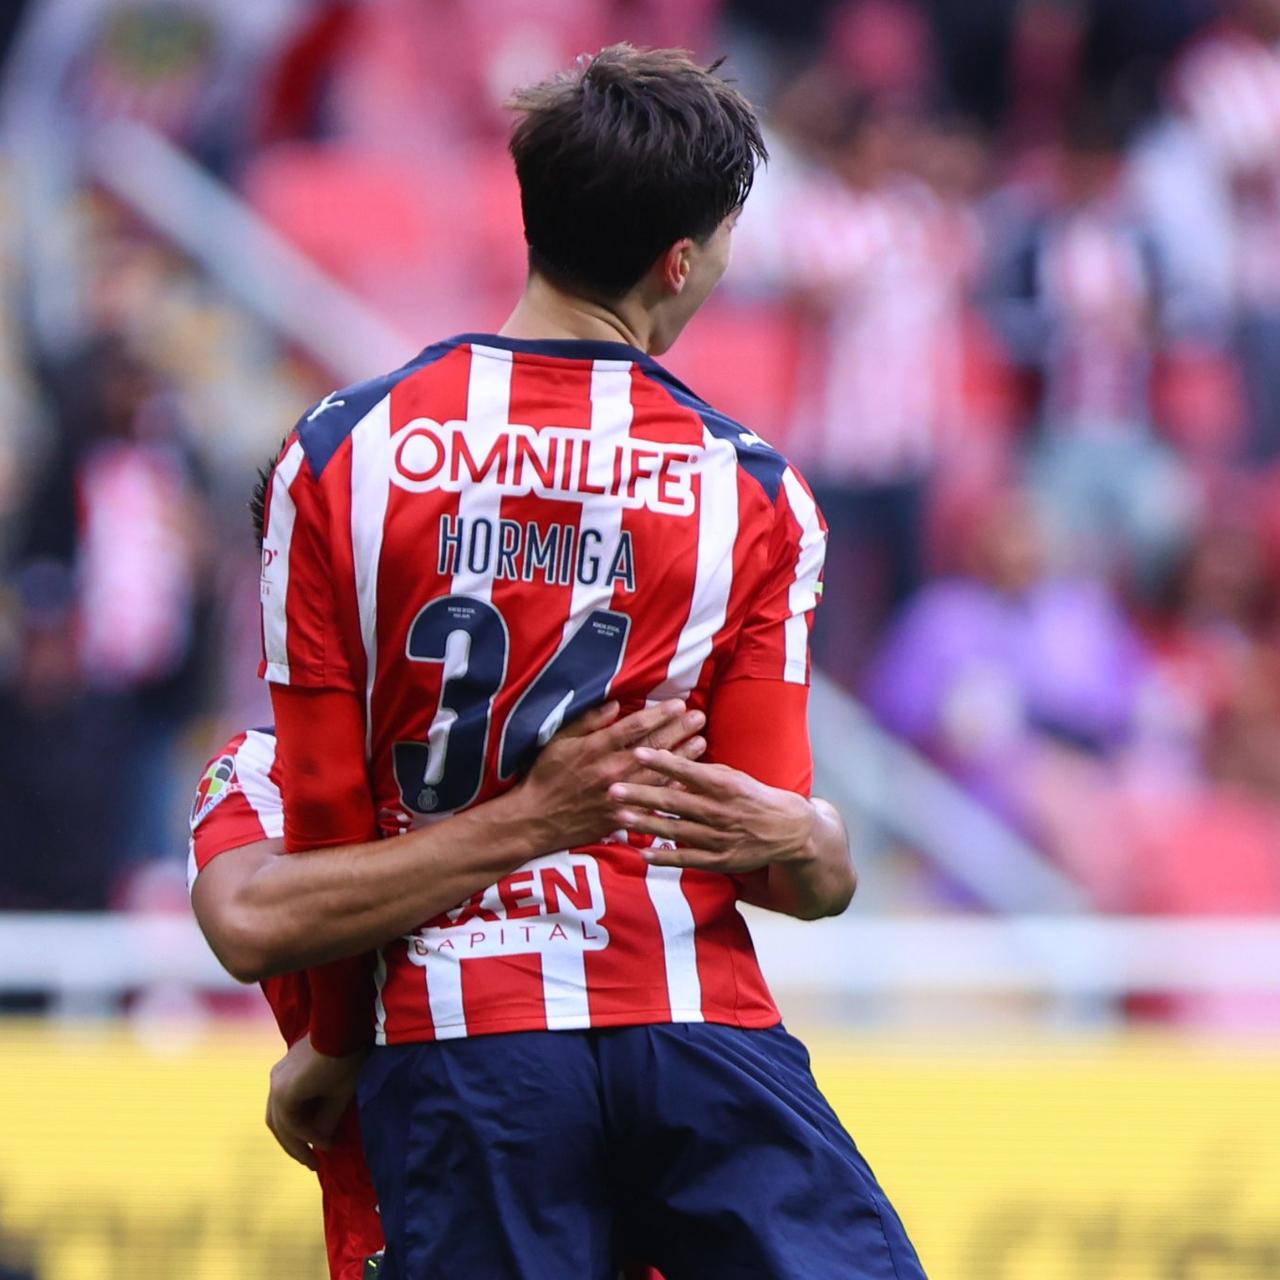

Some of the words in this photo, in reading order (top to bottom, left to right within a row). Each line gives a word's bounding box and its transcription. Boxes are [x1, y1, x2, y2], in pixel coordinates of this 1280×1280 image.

[394, 427, 693, 505] OMNILIFE
[437, 515, 636, 592] HORMIGA
[393, 594, 632, 815] 34
[422, 864, 593, 931] XEN
[413, 920, 599, 956] CAPITAL
